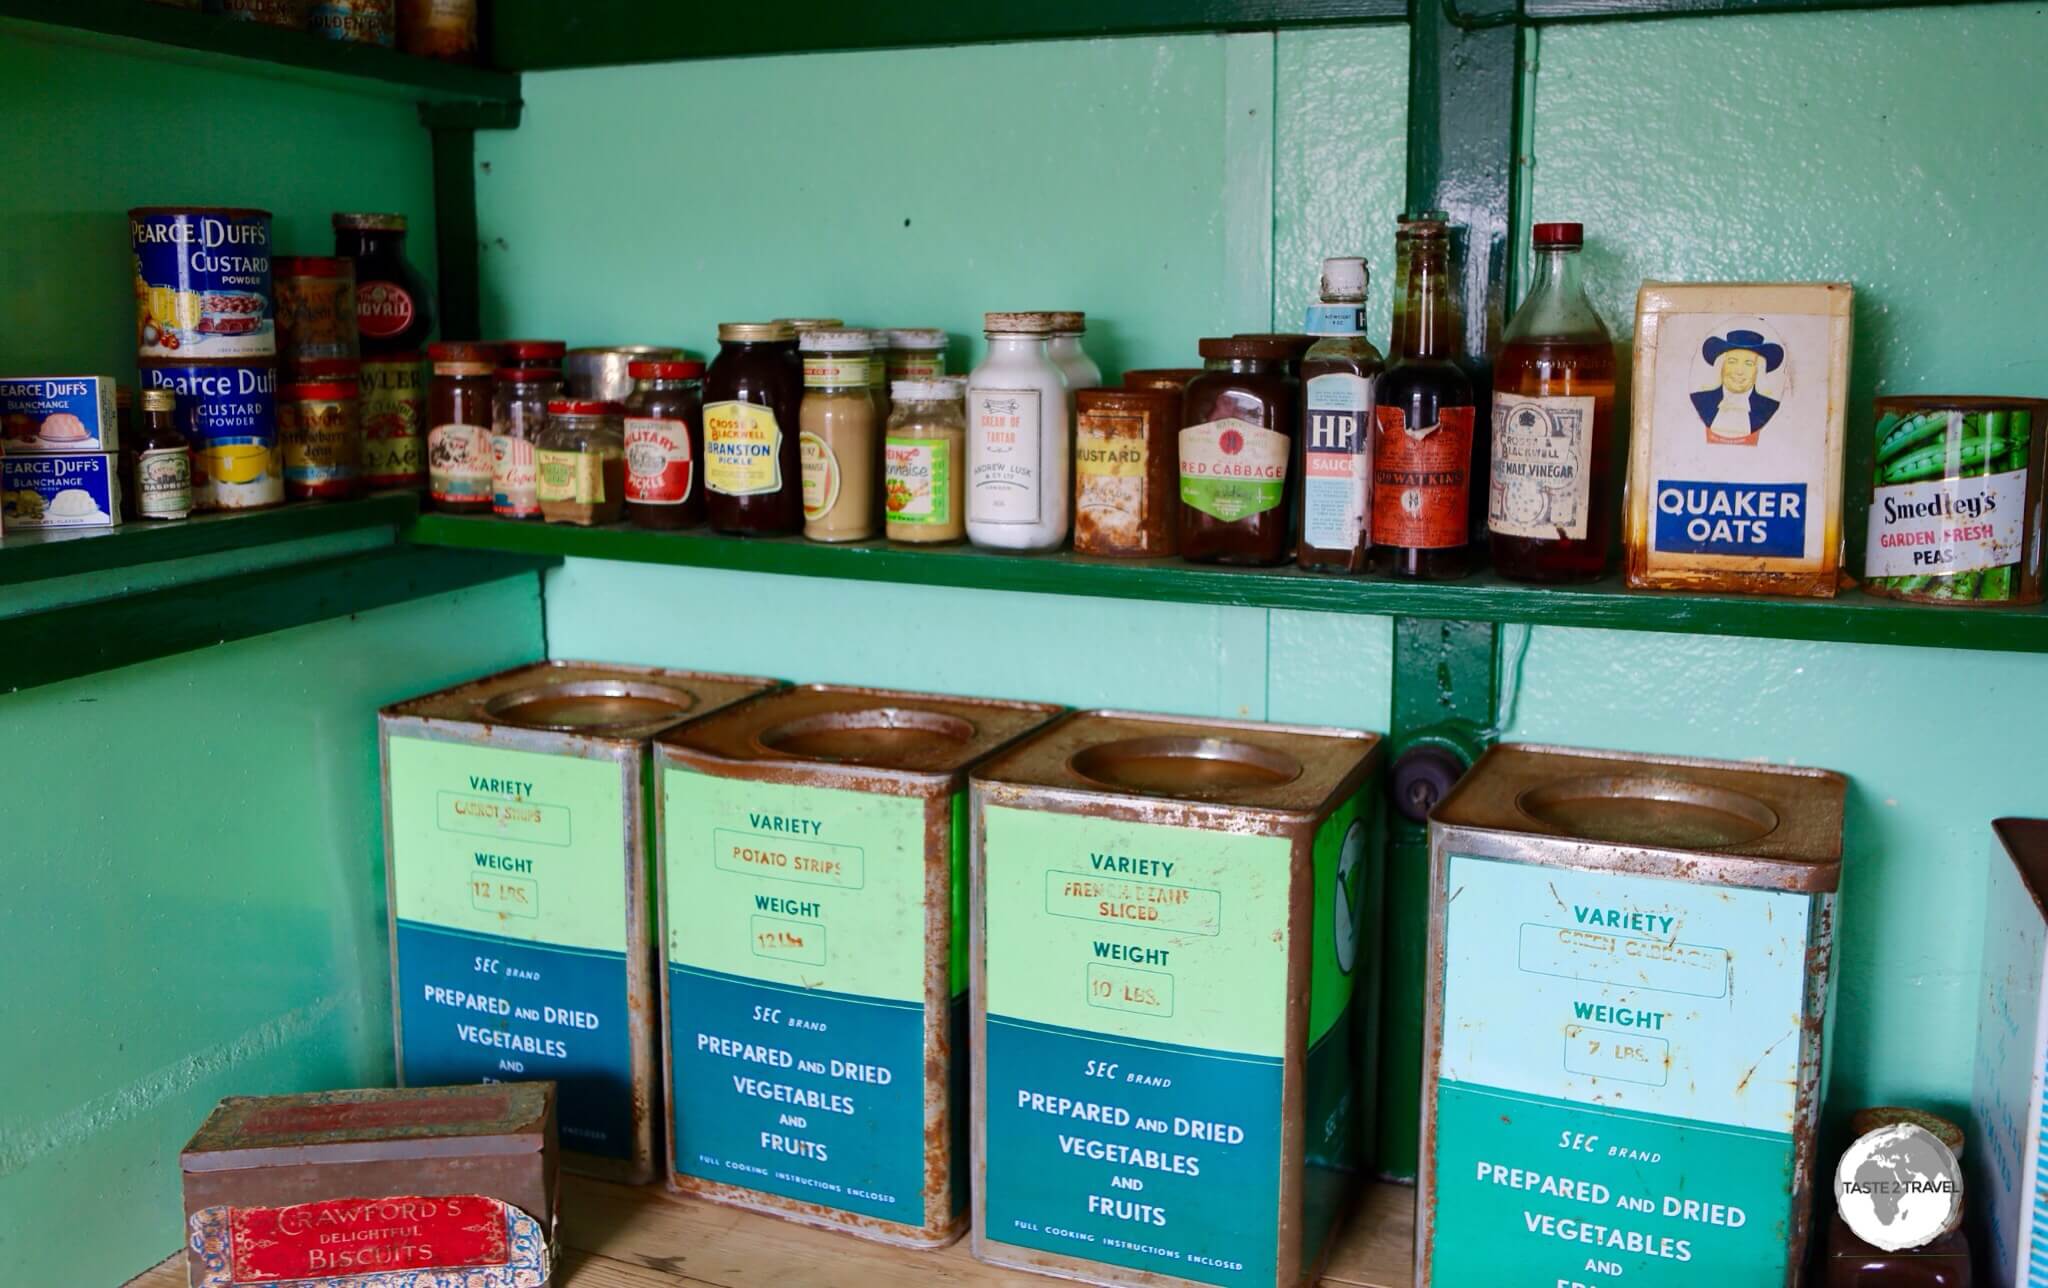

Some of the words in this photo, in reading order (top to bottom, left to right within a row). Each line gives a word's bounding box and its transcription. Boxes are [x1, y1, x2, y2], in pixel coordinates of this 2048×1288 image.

[191, 252, 269, 273] CUSTARD
[151, 369, 232, 396] Pearce
[197, 403, 263, 416] CUSTARD
[209, 417, 255, 427] POWDER
[712, 430, 767, 441] BLACKWELL
[1311, 414, 1358, 448] HP
[708, 442, 770, 456] BRANSTON
[719, 457, 752, 465] PICKLE
[13, 477, 84, 488] BLANCMANGE
[1182, 462, 1207, 474] RED
[1212, 463, 1284, 478] CABBAGE
[1506, 462, 1527, 475] MALT
[1528, 464, 1574, 478] VINEGAR
[1658, 488, 1801, 519] QUAKER
[1884, 493, 1997, 525] Smedley's
[1687, 519, 1769, 544] OATS
[1880, 531, 1936, 548] GARDEN
[1943, 525, 1994, 543] FRESH
[470, 776, 533, 797] VARIETY
[749, 813, 822, 835] VARIETY
[475, 852, 533, 874] WEIGHT
[732, 846, 788, 867] POTATO
[793, 857, 842, 877] STRIPS
[1090, 853, 1175, 878] VARIETY
[473, 881, 491, 898] 12
[754, 895, 822, 918] WEIGHT
[1099, 902, 1159, 921] SLICED
[1574, 905, 1675, 934] VARIETY
[1093, 941, 1170, 967] WEIGHT
[473, 956, 501, 975] SEC
[505, 967, 541, 981] BRAND
[1092, 978, 1113, 998] 10
[423, 984, 511, 1016] PREPARED
[514, 1007, 541, 1022] AND
[543, 1005, 600, 1031] DRIED
[752, 1005, 782, 1025] SEC
[788, 1017, 828, 1032] BRAND
[1574, 1001, 1665, 1031] WEIGHT
[456, 1023, 568, 1059] VEGETABLES
[498, 1059, 525, 1073] AND
[697, 1033, 793, 1069] PREPARED
[797, 1059, 826, 1075] AND
[830, 1059, 892, 1086] DRIED
[1084, 1060, 1120, 1080] SEC
[1126, 1072, 1173, 1089] BRAND
[733, 1075, 856, 1116] VEGETABLES
[779, 1113, 808, 1129] AND
[1018, 1089, 1131, 1128] PREPARED
[1135, 1116, 1169, 1134] AND
[1173, 1116, 1245, 1146] DRIED
[760, 1131, 829, 1163] FRUITS
[1058, 1134, 1201, 1178] VEGETABLES
[1559, 1130, 1600, 1153] SEC
[1607, 1146, 1662, 1164] BRAND
[699, 1154, 721, 1167] FULL
[725, 1160, 769, 1177] COOKING
[775, 1171, 842, 1193] INSTRUCTIONS
[847, 1187, 896, 1204] ENCLOSED
[1110, 1175, 1144, 1191] AND
[1476, 1161, 1611, 1206] PREPARED
[1616, 1194, 1656, 1214] AND
[1662, 1195, 1747, 1229] DRIED
[1088, 1194, 1167, 1228] FRUITS
[320, 1225, 423, 1245] DELIGHTFUL
[1014, 1219, 1039, 1232] FULL
[1045, 1226, 1095, 1243] COOKING
[1103, 1237, 1181, 1260] INSTRUCTIONS
[1187, 1254, 1244, 1272] ENCLOSED
[1523, 1211, 1692, 1263] VEGETABLES
[309, 1243, 434, 1270] BISCUITS
[1585, 1258, 1624, 1277] AND
